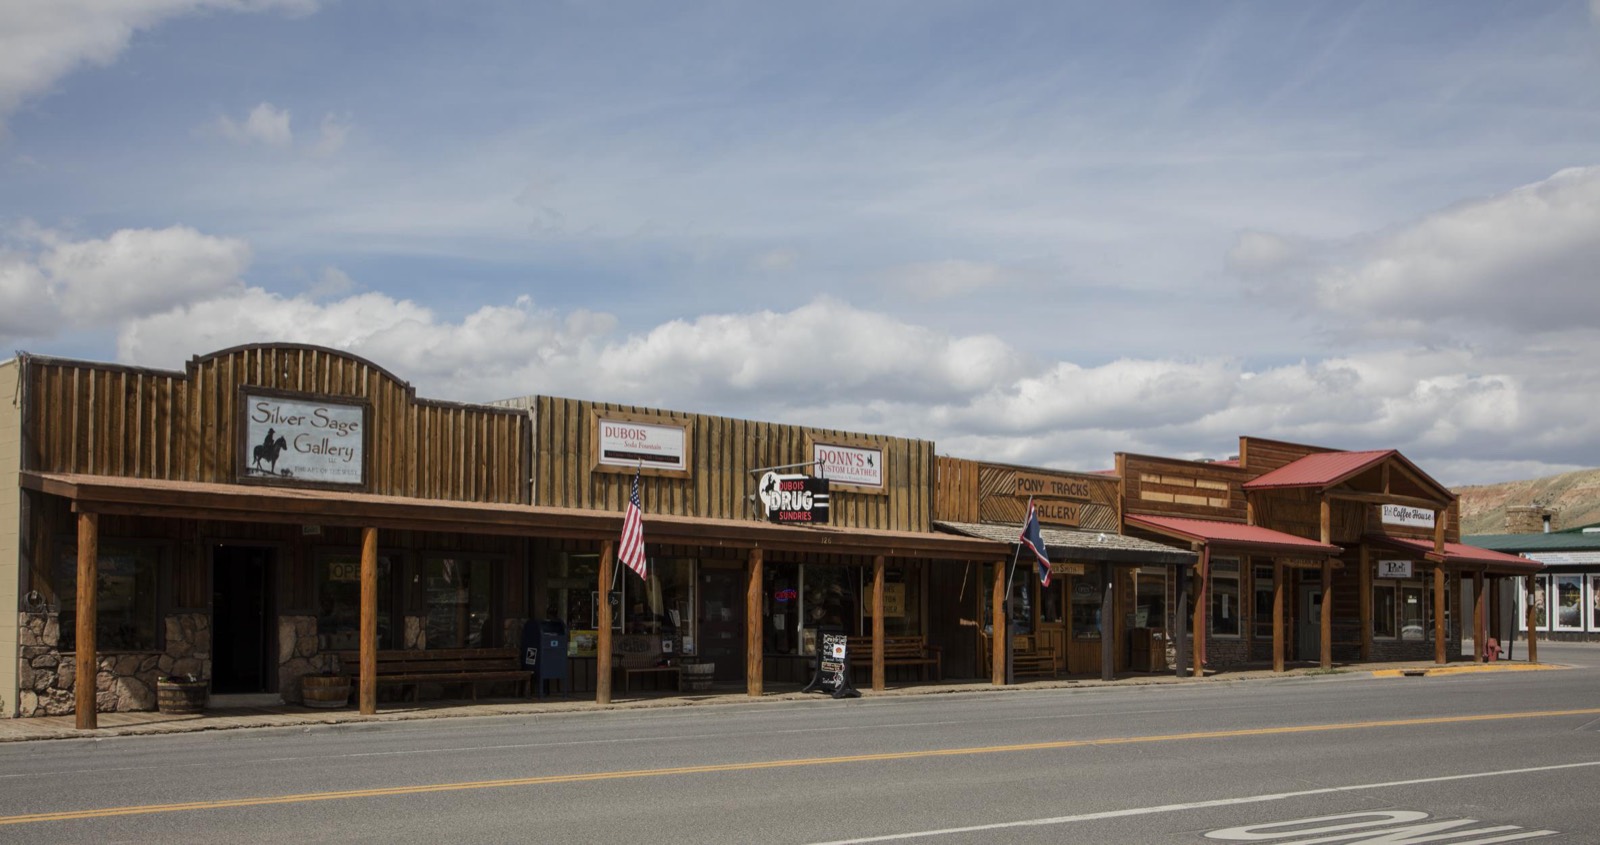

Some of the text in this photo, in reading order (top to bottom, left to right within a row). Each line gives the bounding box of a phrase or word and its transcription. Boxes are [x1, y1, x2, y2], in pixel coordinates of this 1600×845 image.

[251, 402, 358, 437] Silver Sage
[605, 426, 647, 441] DUBOIS
[294, 433, 354, 463] Gallery
[624, 441, 662, 451] Soda Fountain
[819, 449, 865, 468] DONN'S
[818, 464, 845, 474] CUSTOM
[847, 467, 877, 478] LEATHER
[779, 480, 804, 491] DUBOIS
[1018, 478, 1089, 497] PONY TRACKS
[769, 490, 813, 511] DRUG
[779, 511, 812, 521] SUNDRIES
[1392, 506, 1412, 522] Coffee
[1411, 508, 1431, 521] House
[820, 536, 832, 545] 126
